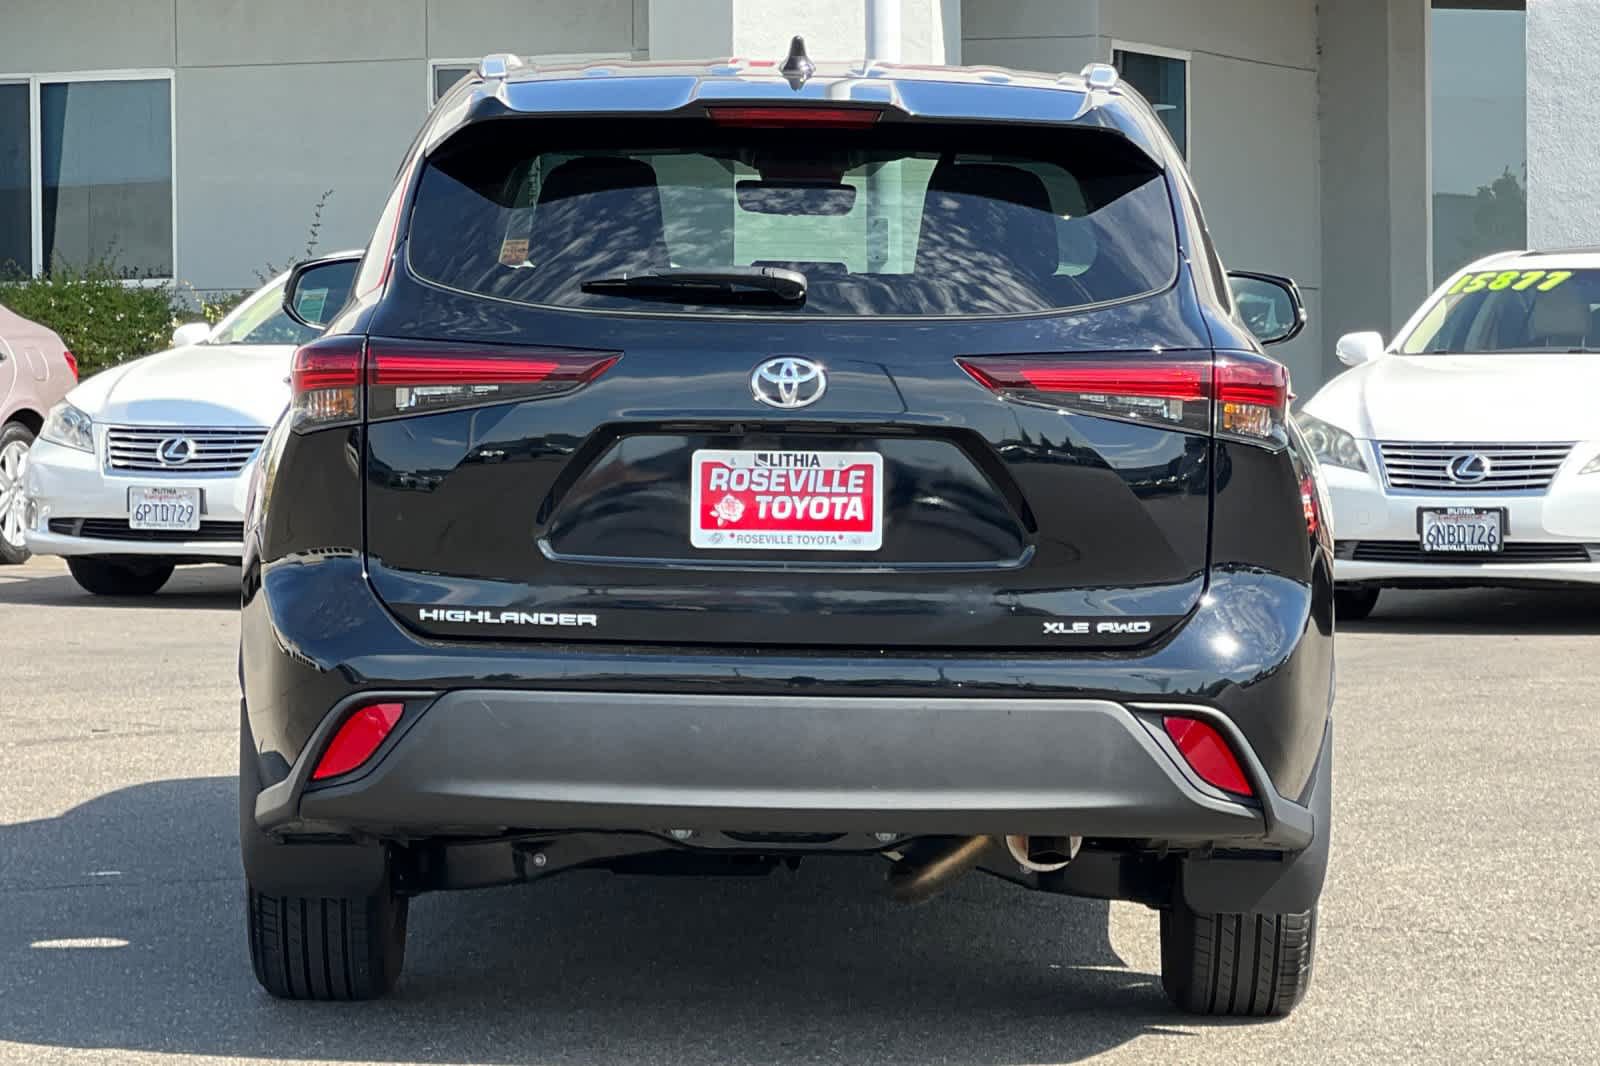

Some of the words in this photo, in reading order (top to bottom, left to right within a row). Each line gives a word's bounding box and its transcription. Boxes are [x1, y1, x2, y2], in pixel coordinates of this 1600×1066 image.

[1448, 270, 1572, 294] 15877
[770, 454, 820, 467] LITHIA
[709, 468, 865, 493] ROSEVILLE
[135, 503, 194, 523] 6PTD729
[755, 495, 864, 520] TOYOTA
[736, 535, 793, 545] ROSEVILLE
[796, 535, 837, 545] TOYOTA
[1426, 524, 1496, 546] 6NBD726
[419, 608, 597, 626] HIGHLANDER
[1043, 622, 1089, 634] XLE
[1096, 621, 1151, 633] AWD
